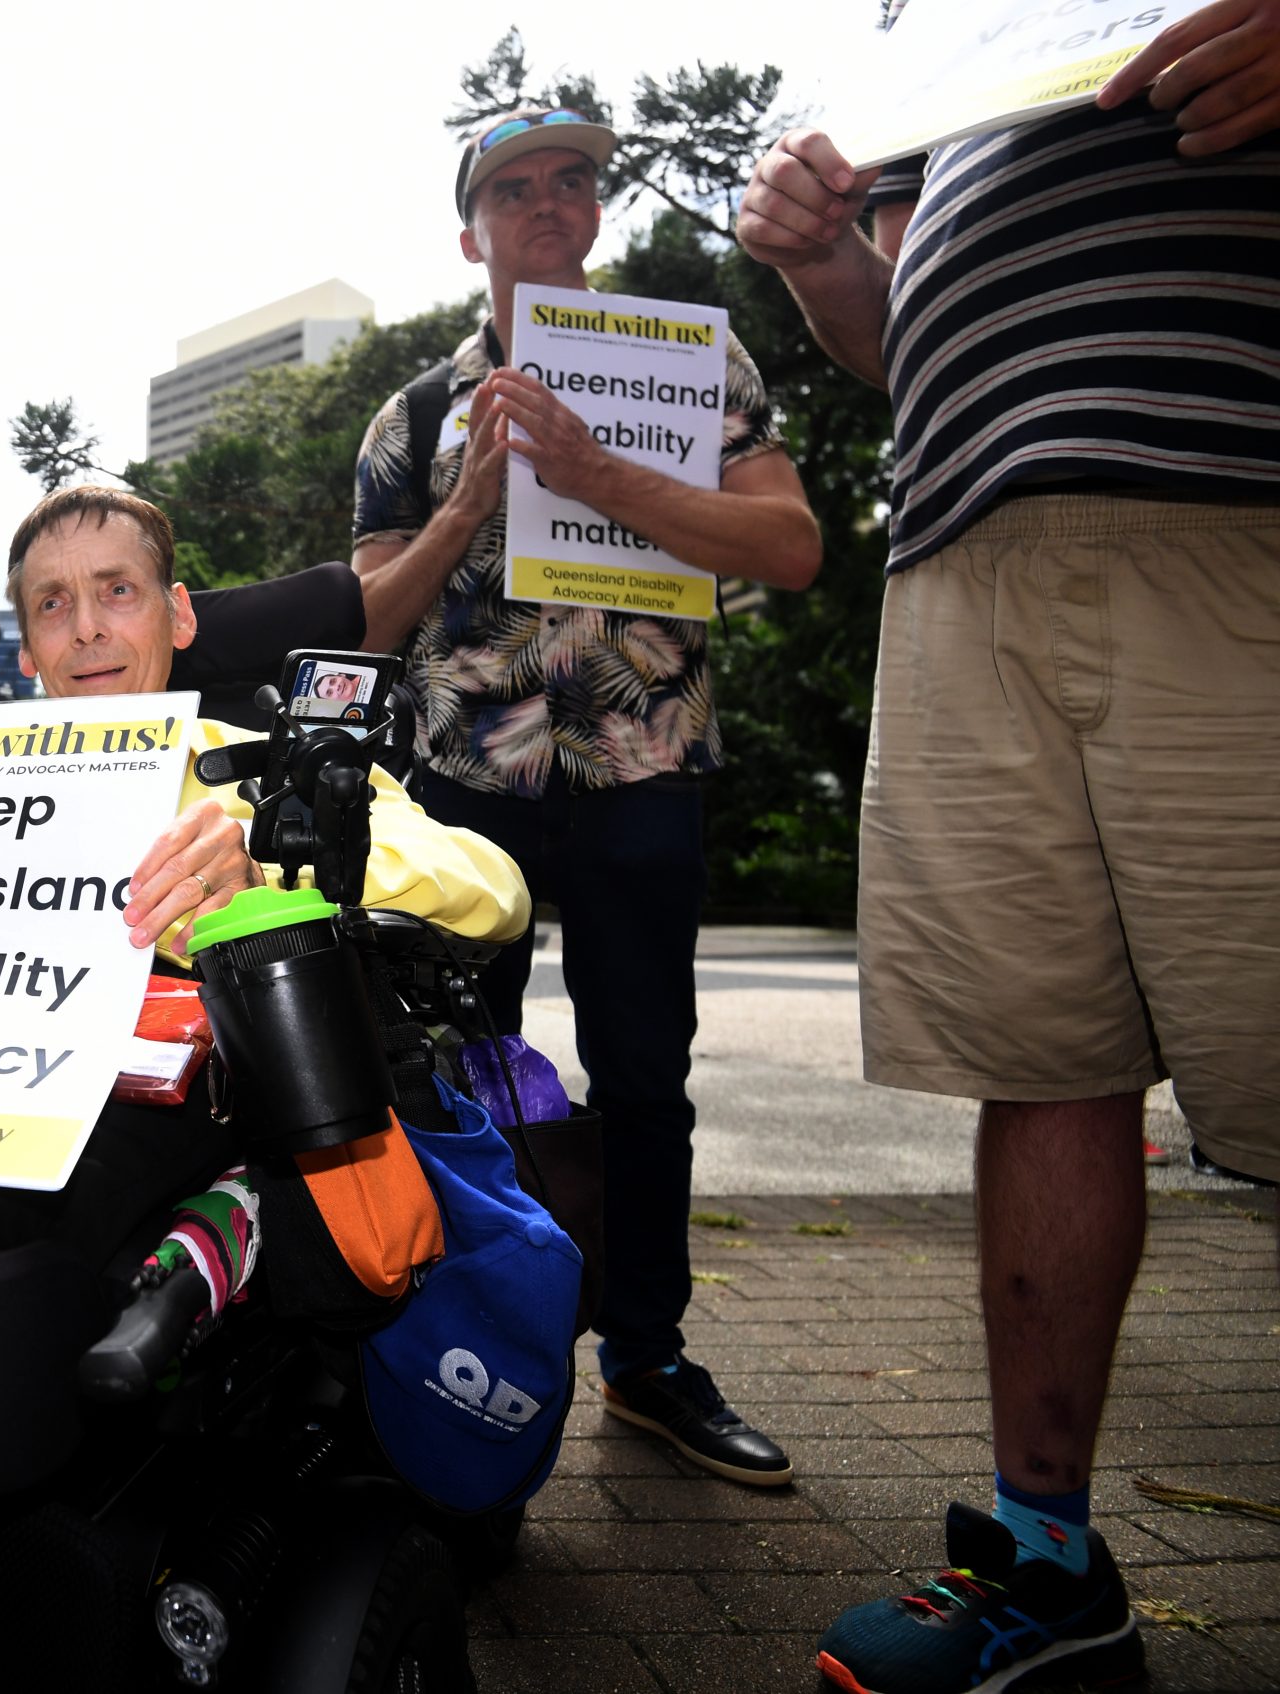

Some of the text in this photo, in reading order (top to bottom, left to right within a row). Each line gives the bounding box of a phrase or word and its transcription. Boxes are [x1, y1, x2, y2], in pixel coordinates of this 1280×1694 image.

[533, 303, 711, 348] Stand with us!
[587, 421, 695, 464] ability
[551, 519, 659, 551] matte
[543, 567, 625, 586] Queensland
[552, 586, 675, 610] Advocacy Alliance
[101, 716, 176, 753] us!
[6, 763, 86, 775] ADVOCACY
[88, 761, 161, 772] MATTERS.
